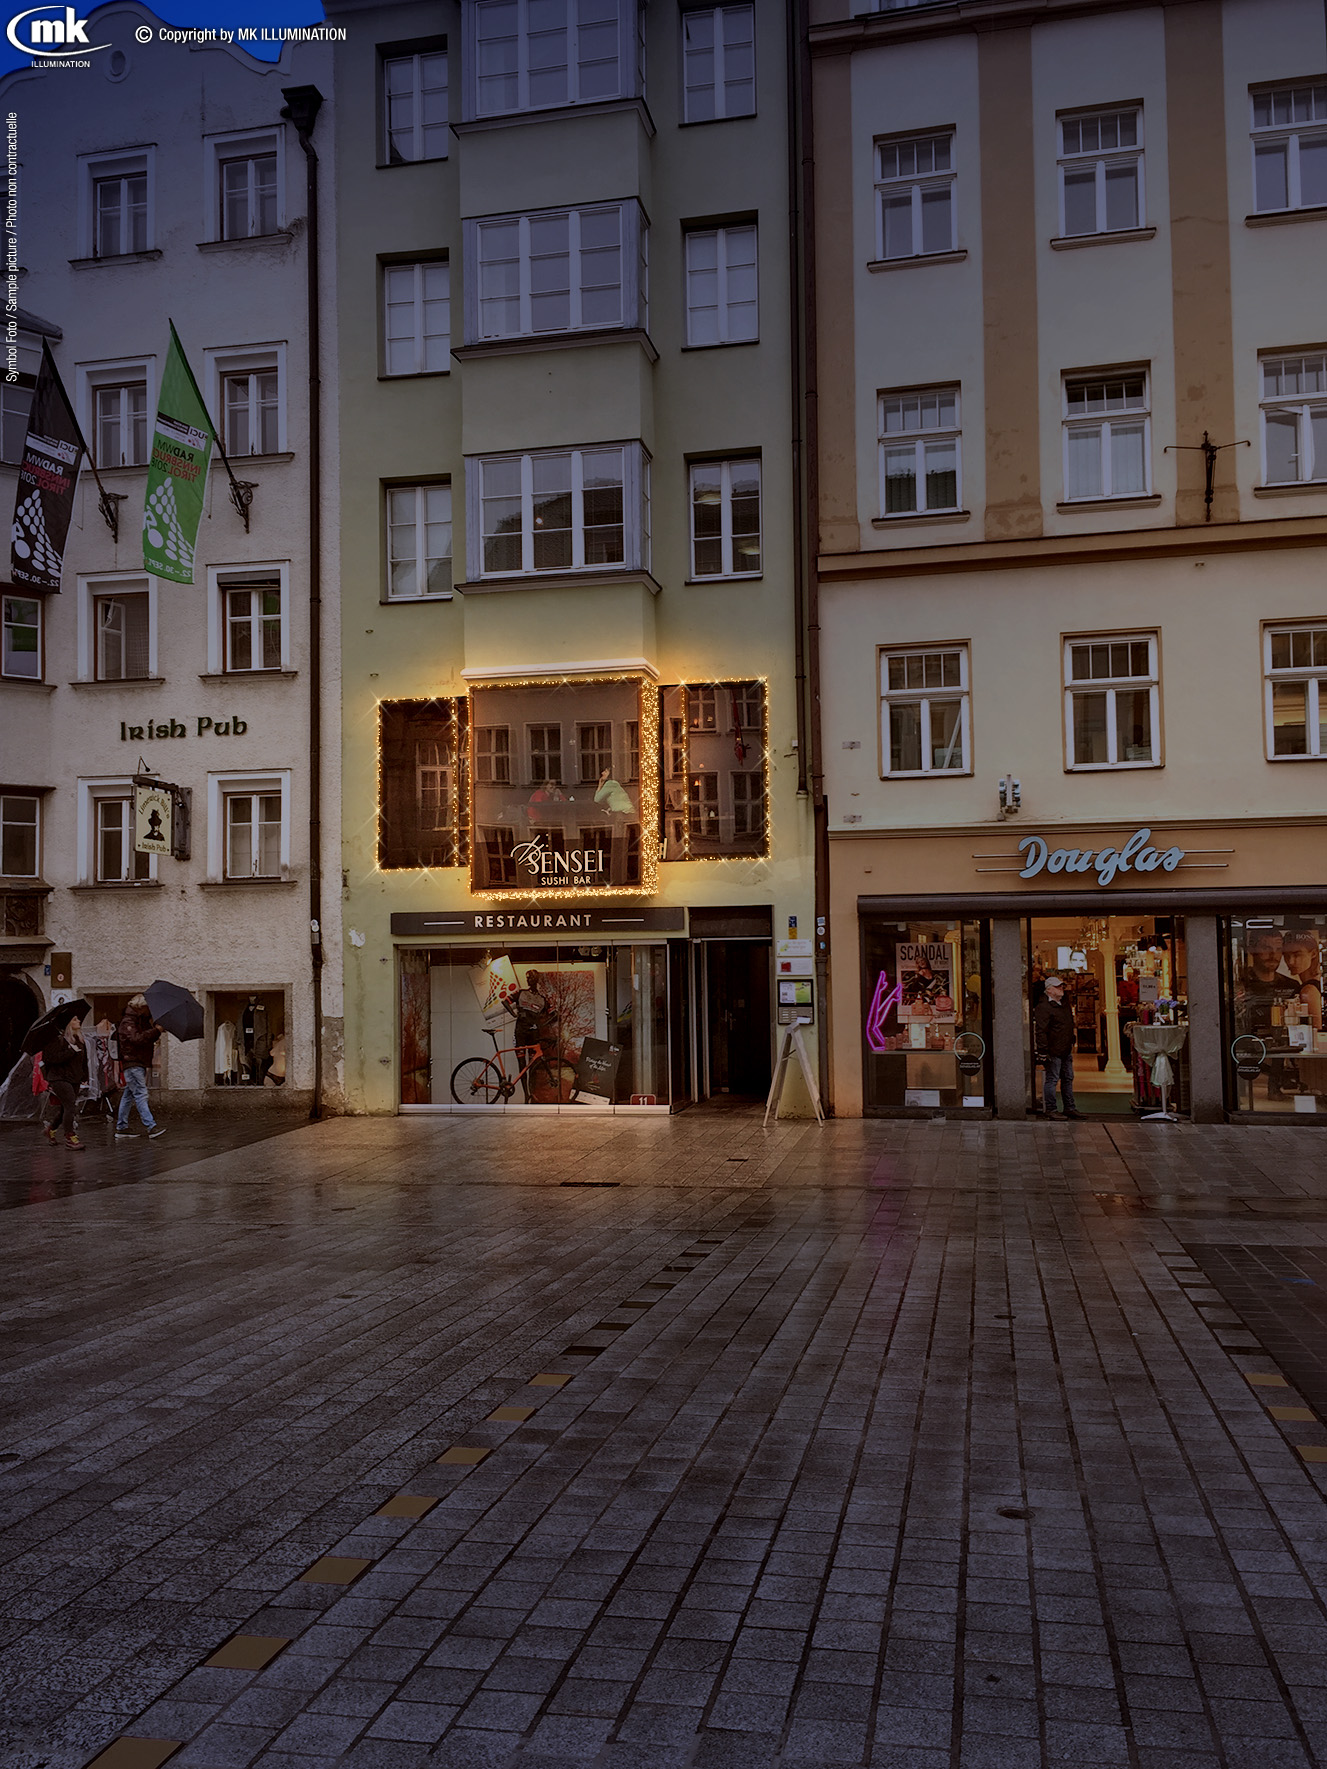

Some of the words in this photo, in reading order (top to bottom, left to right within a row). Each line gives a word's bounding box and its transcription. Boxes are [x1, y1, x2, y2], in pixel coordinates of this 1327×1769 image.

[121, 718, 187, 741] Irish
[197, 716, 248, 737] Pub
[528, 850, 604, 875] SENSEI
[1018, 828, 1186, 887] Douglas
[541, 876, 569, 886] SUSHI
[573, 875, 591, 885] BAR
[474, 914, 592, 928] RESTAURANT
[900, 944, 949, 961] SCANDAL
[638, 1096, 648, 1105] 11
